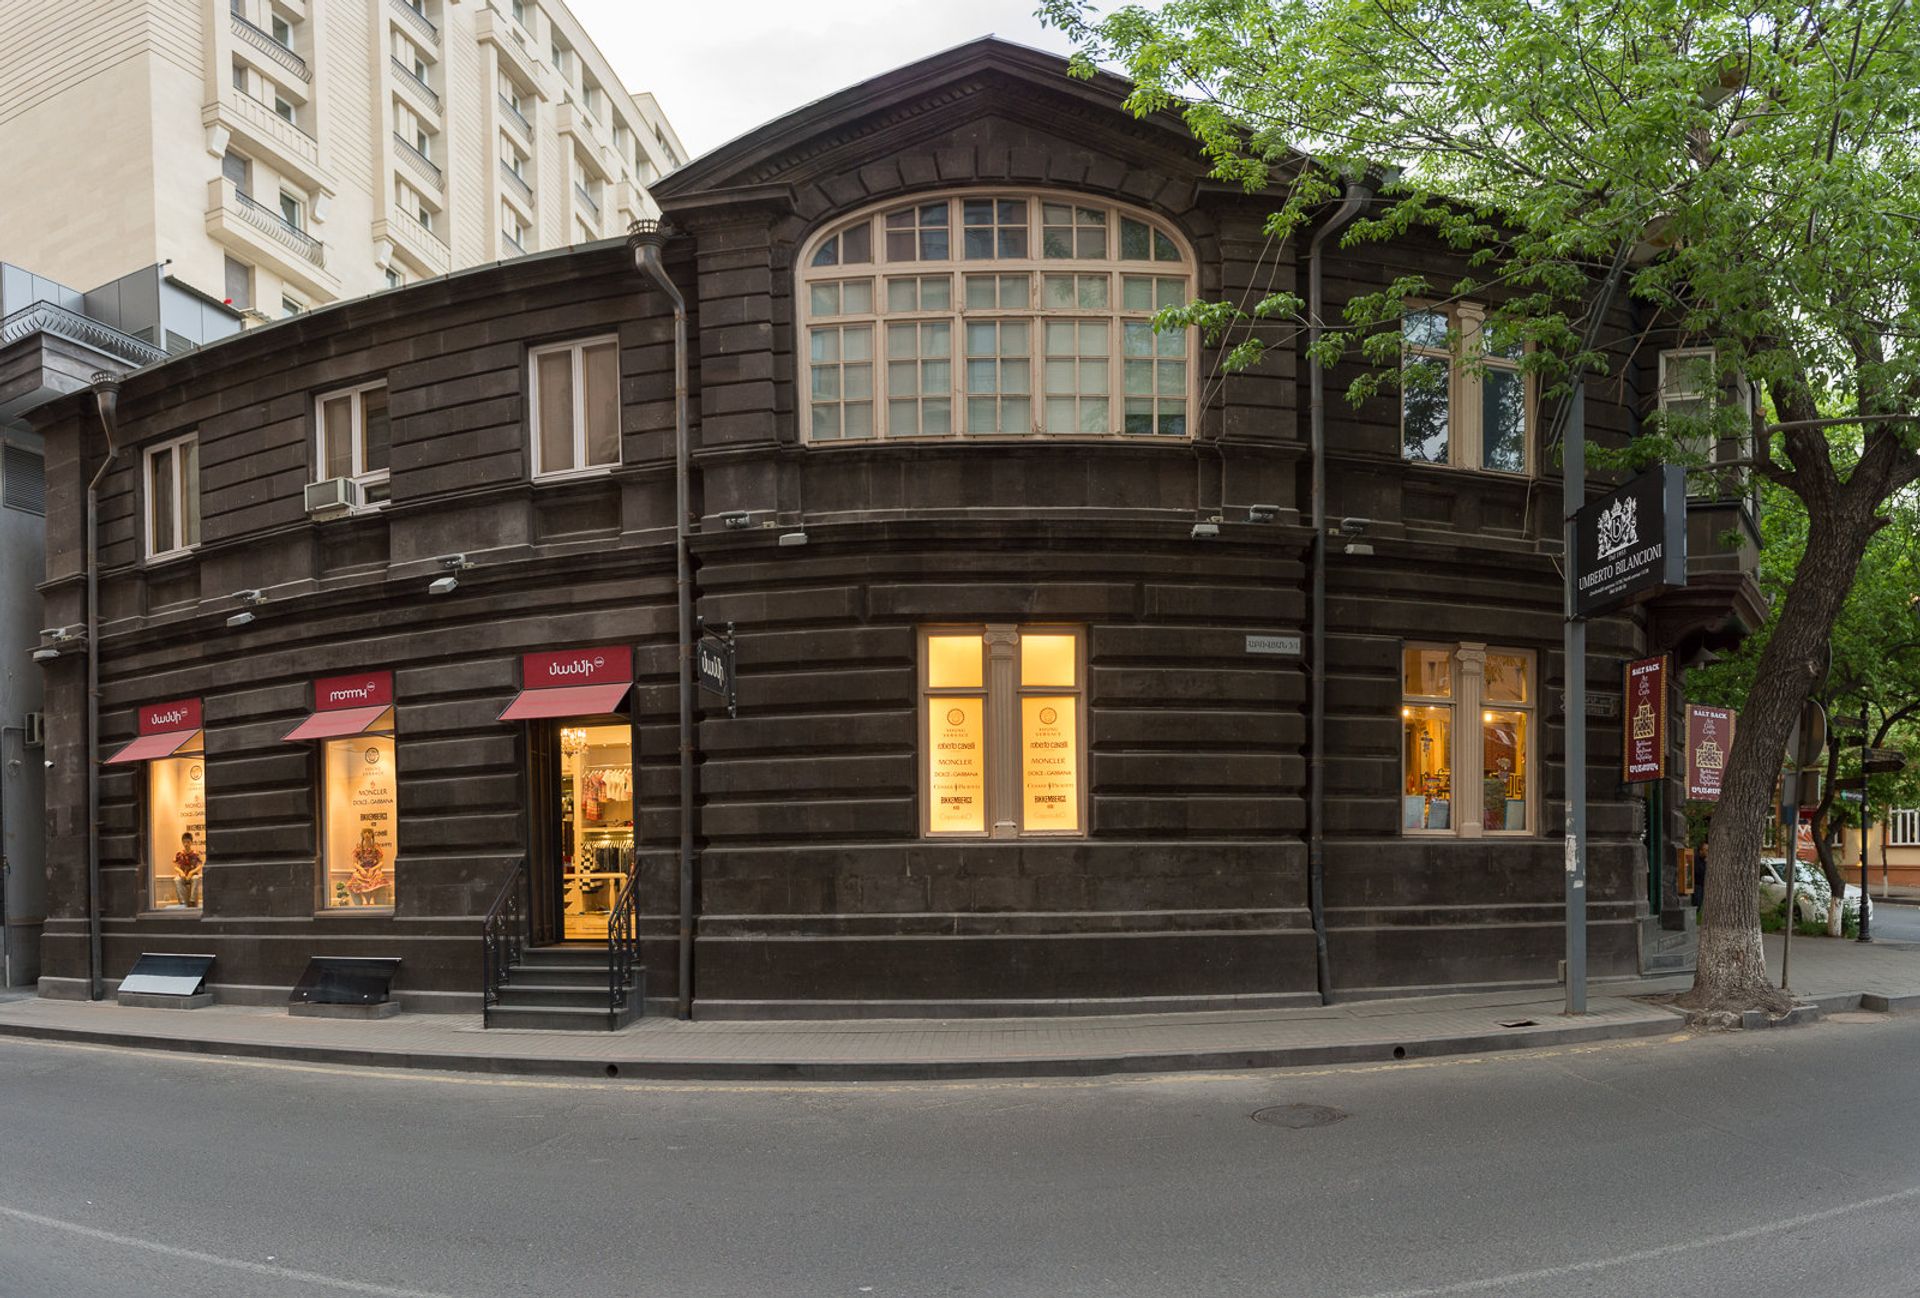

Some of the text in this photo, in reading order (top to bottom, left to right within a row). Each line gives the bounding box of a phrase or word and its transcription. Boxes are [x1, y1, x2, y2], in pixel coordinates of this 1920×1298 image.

[1579, 565, 1613, 590] UMBERTO
[1615, 543, 1662, 575] BILANCIONI
[1710, 711, 1728, 719] SACK
